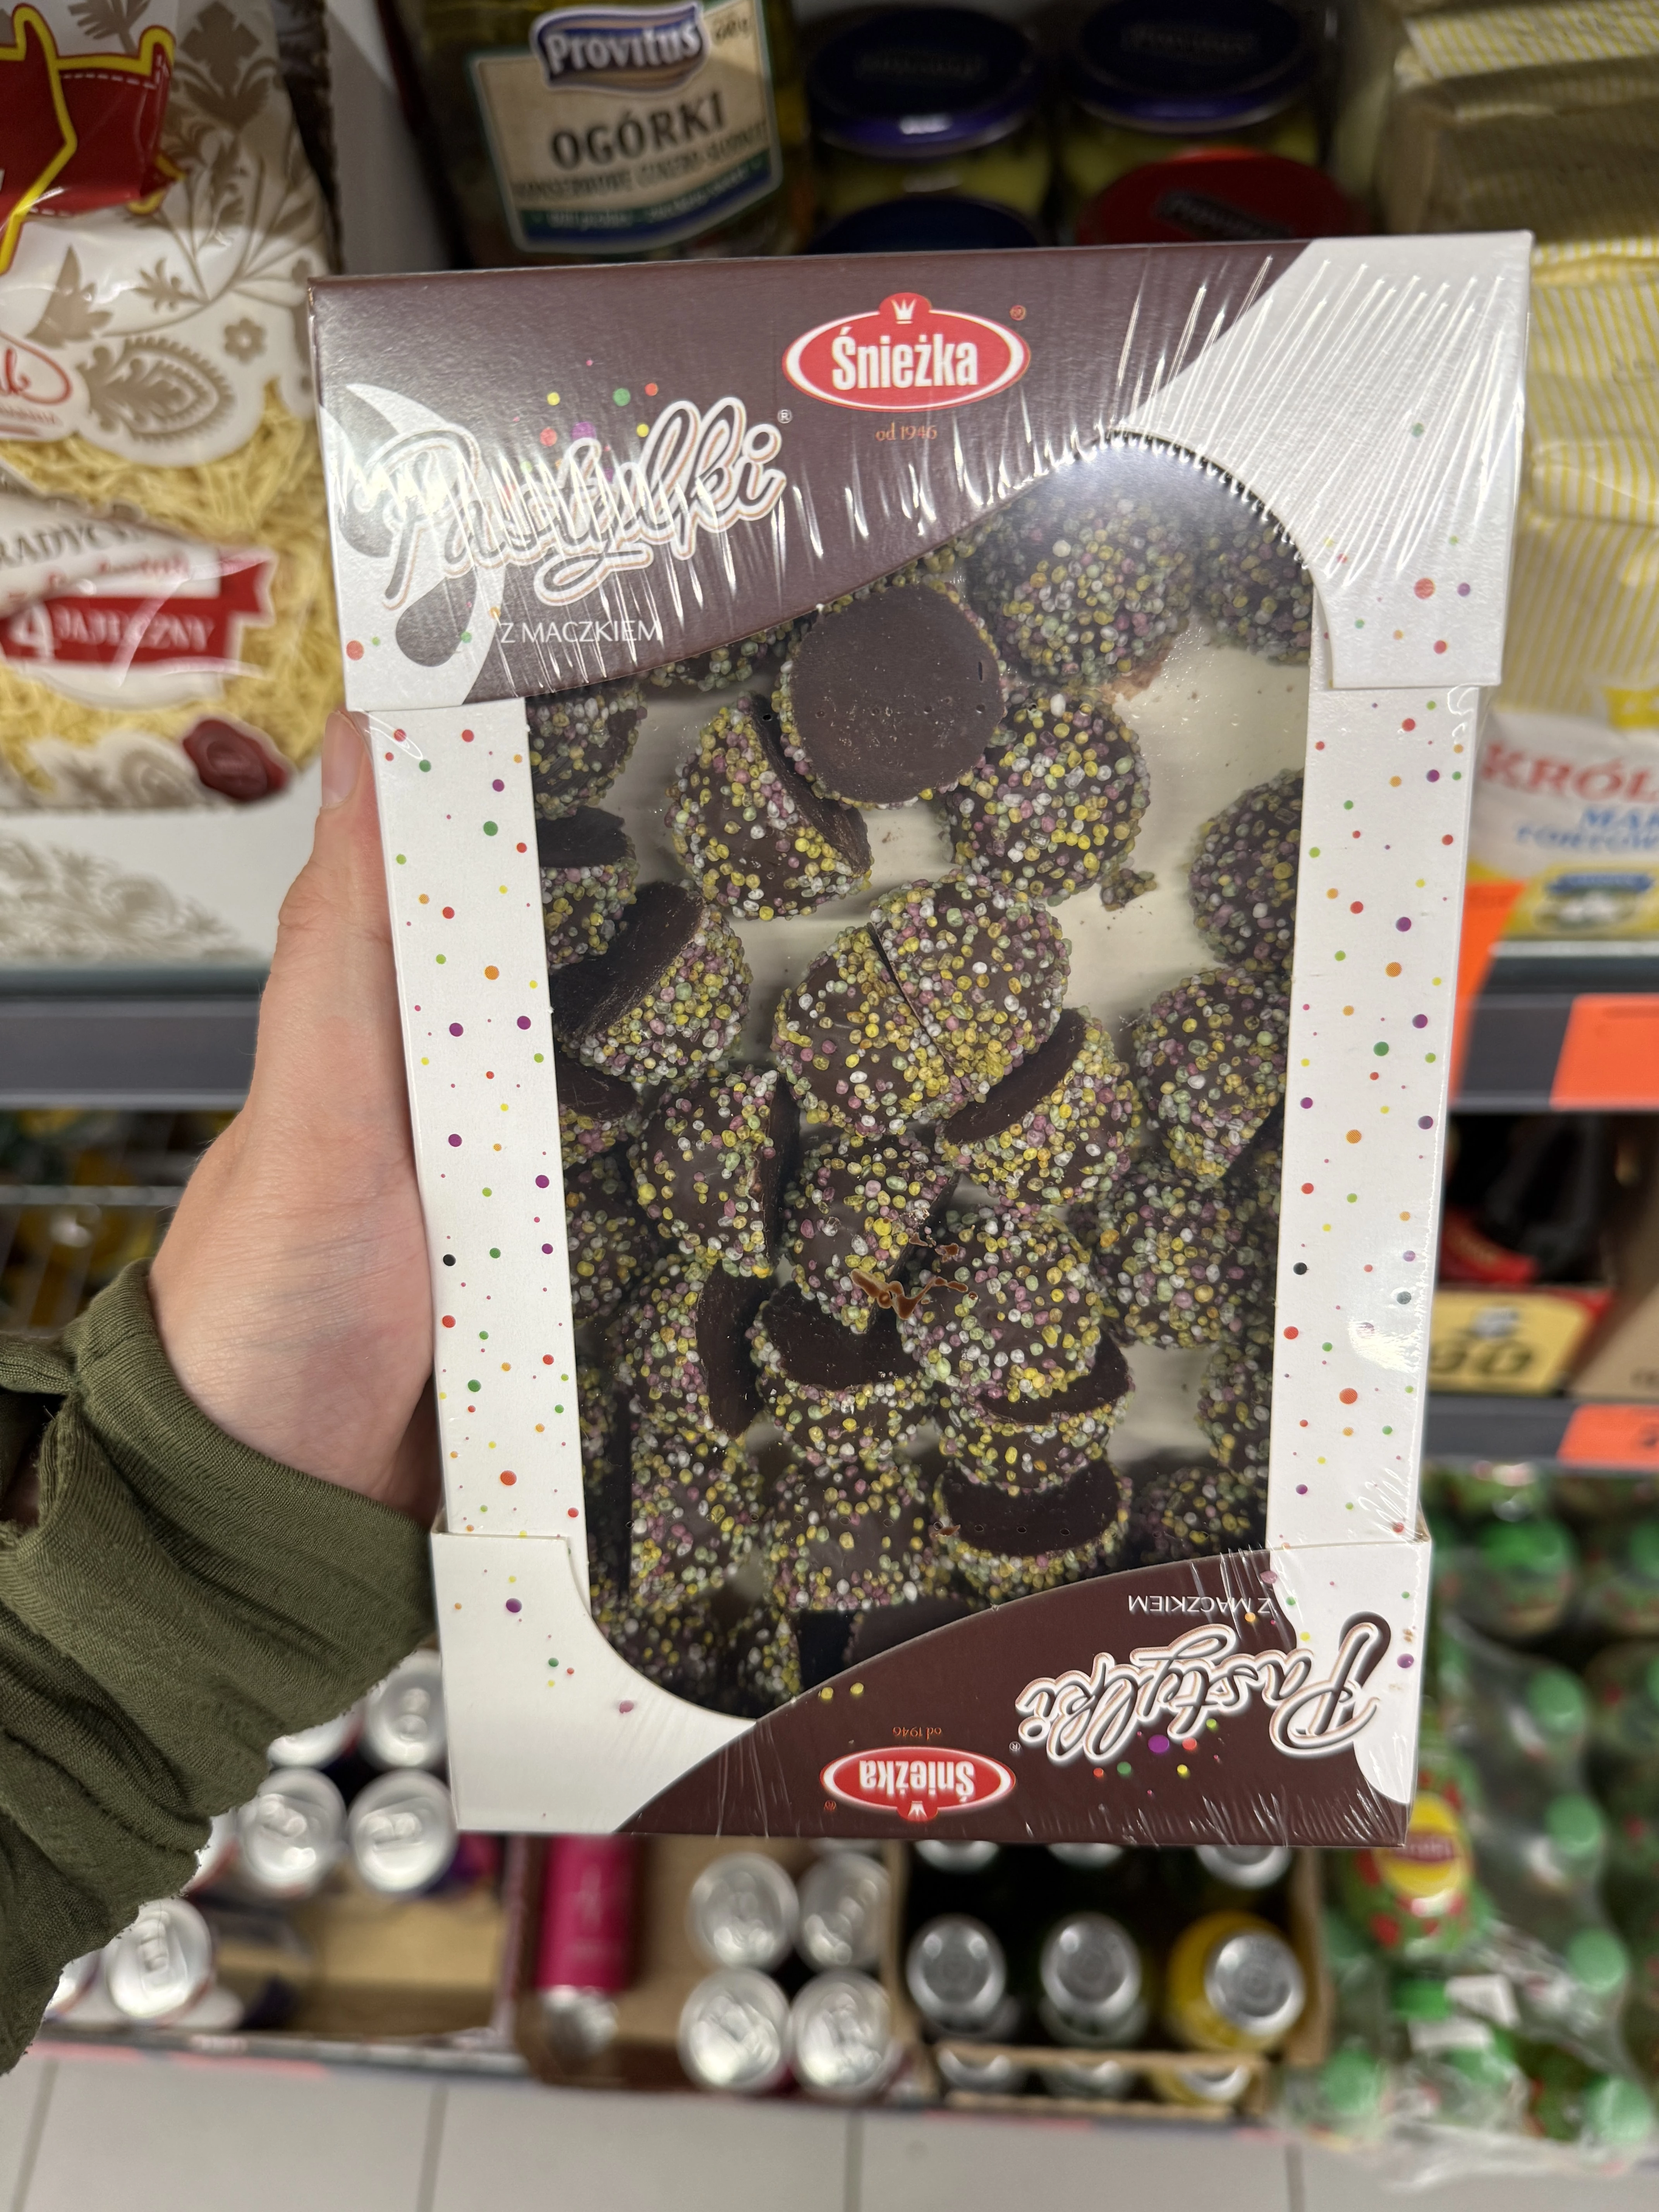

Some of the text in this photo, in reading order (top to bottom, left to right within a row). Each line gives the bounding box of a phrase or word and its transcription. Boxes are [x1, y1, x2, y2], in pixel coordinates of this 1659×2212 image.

[544, 21, 703, 74] Provitus
[551, 91, 726, 169] OGÓRKI
[832, 326, 978, 390] Śnieżka
[875, 422, 937, 441] od 1946
[500, 620, 663, 643] Z MACZKIEM
[1128, 1595, 1271, 1613] Z MACZKIEM
[1015, 1623, 1380, 1762] Pastylki
[893, 1726, 942, 1740] od 1946
[859, 1760, 976, 1803] Śnieżka
